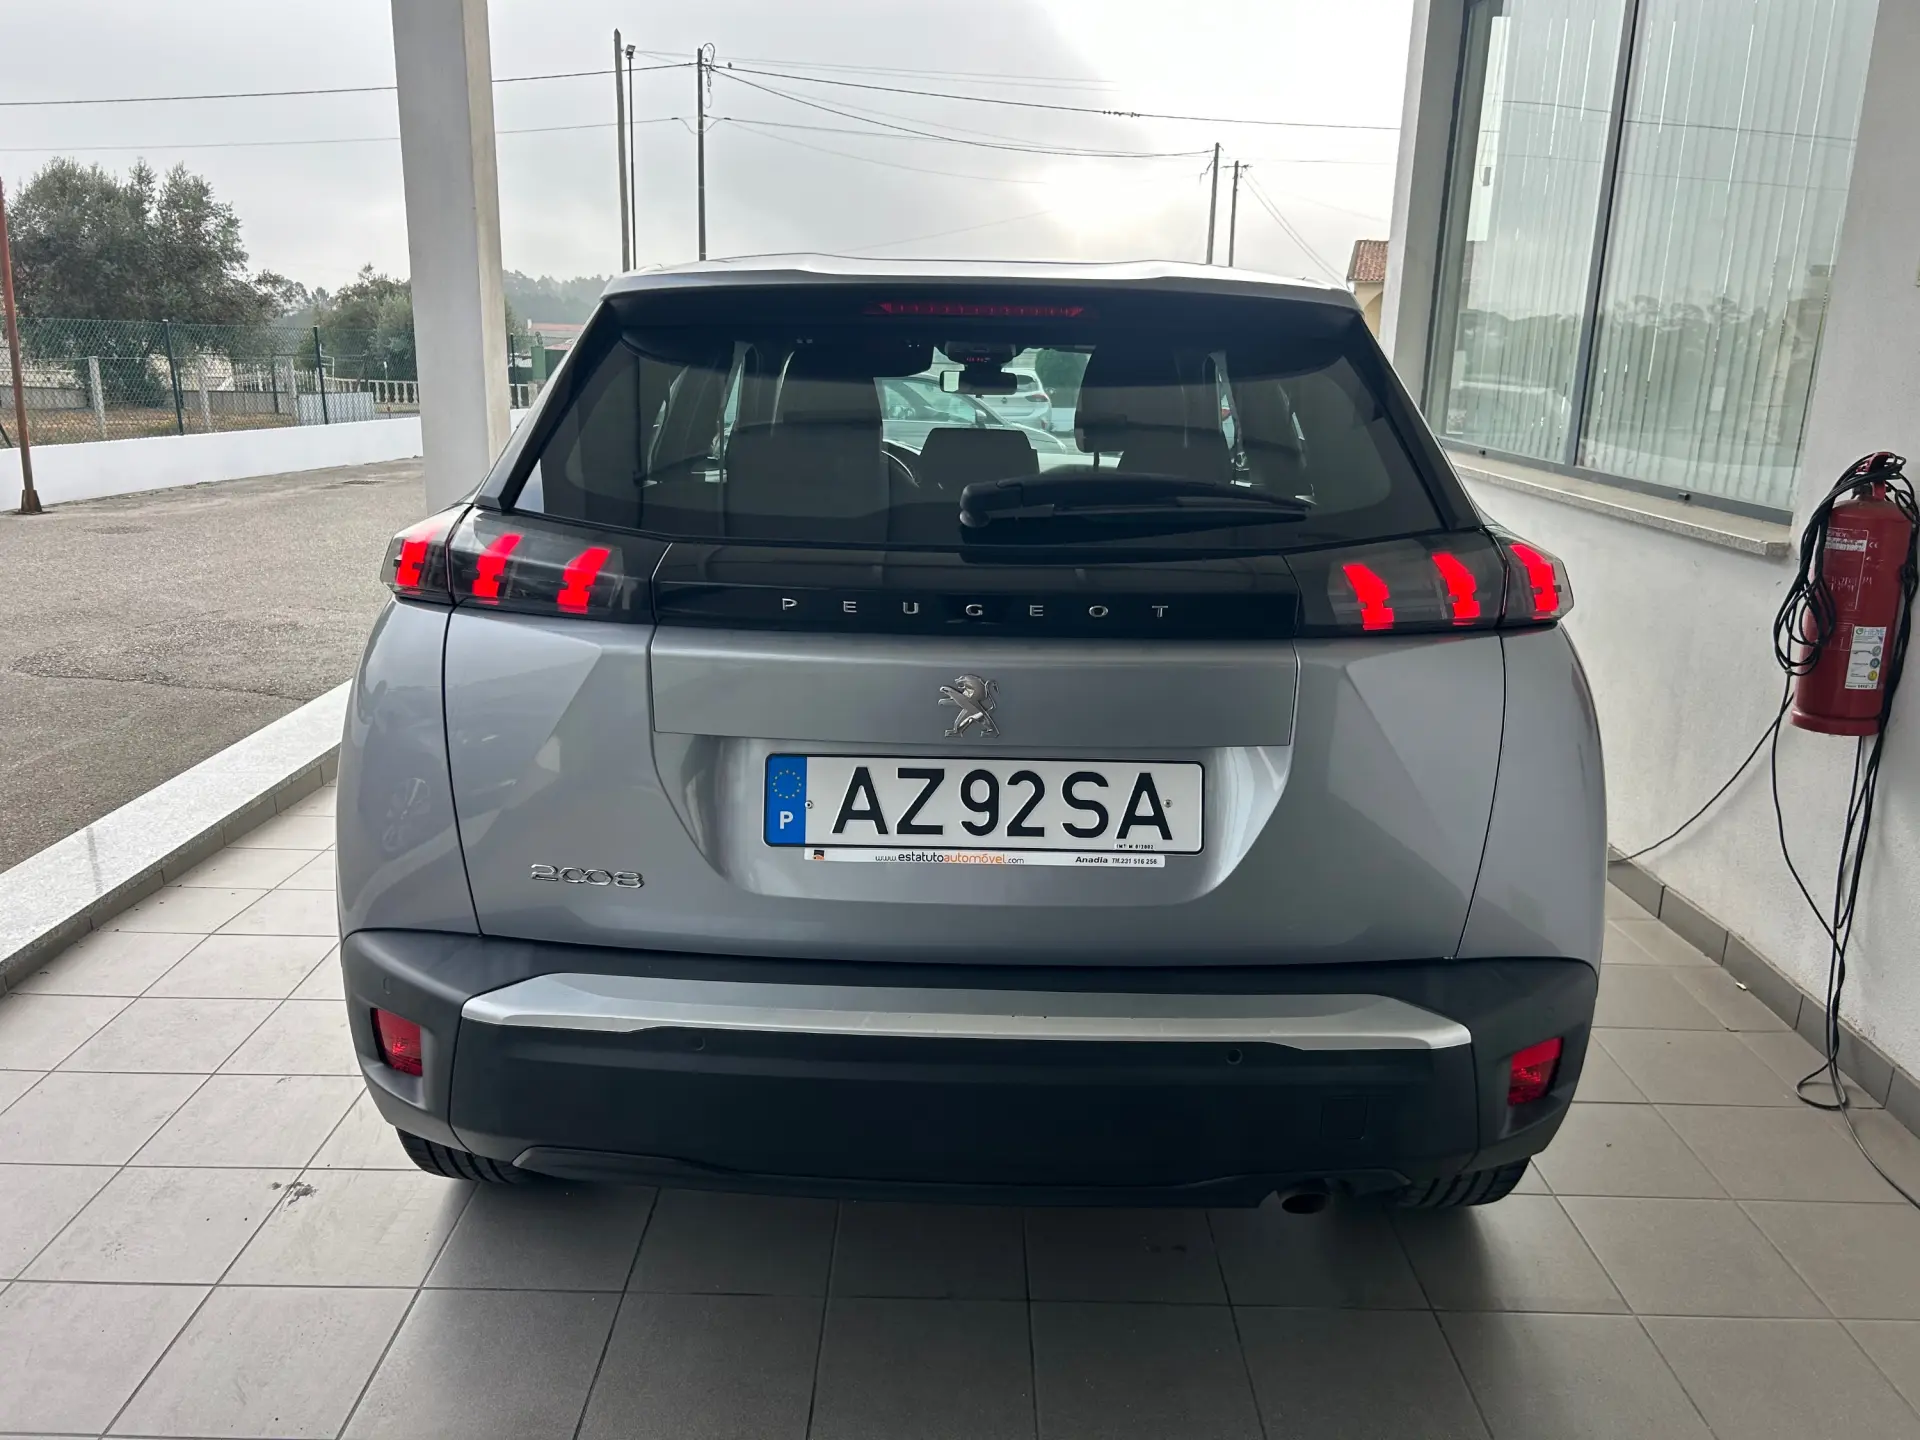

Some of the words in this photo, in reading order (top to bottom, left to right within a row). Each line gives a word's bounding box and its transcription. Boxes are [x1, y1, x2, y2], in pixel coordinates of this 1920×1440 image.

[781, 597, 1170, 618] PEUGEOT
[779, 811, 794, 830] P
[1075, 856, 1109, 864] Anadia
[531, 863, 645, 889] 2008
